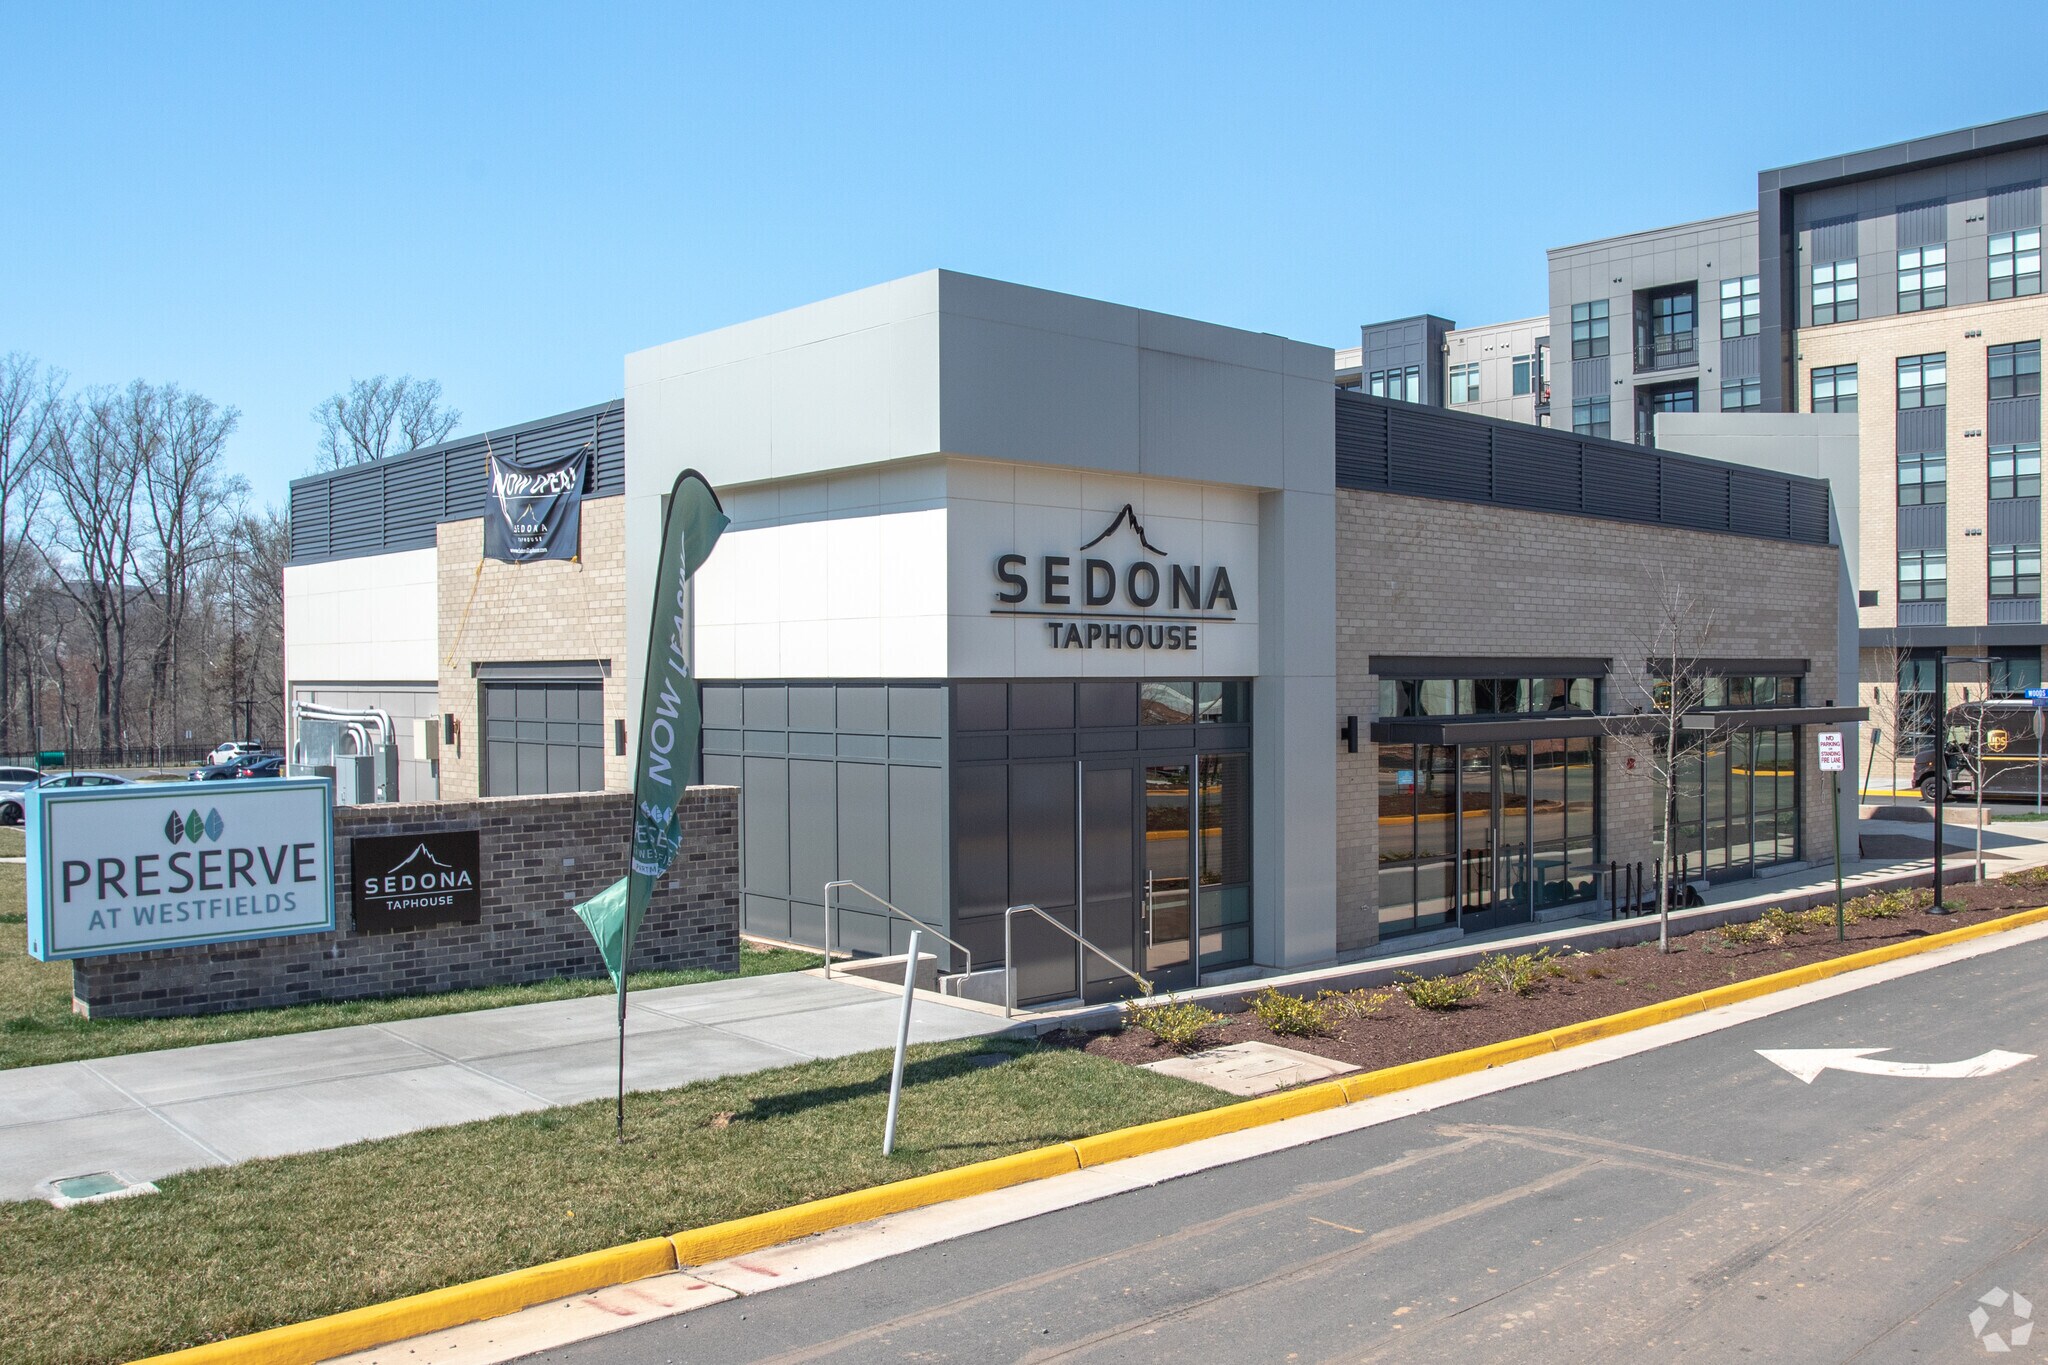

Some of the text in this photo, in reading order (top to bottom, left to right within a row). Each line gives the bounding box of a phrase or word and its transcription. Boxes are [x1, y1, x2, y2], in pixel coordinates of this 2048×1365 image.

[492, 472, 532, 497] NOW
[996, 553, 1238, 611] SEDONA
[1048, 622, 1198, 650] TAPHOUSE
[648, 677, 681, 786] NOW
[63, 842, 317, 903] PRESERVE
[364, 869, 473, 895] SEDONA
[89, 891, 297, 931] AT WESTFIELDS
[386, 895, 454, 911] TAPHOUSE
